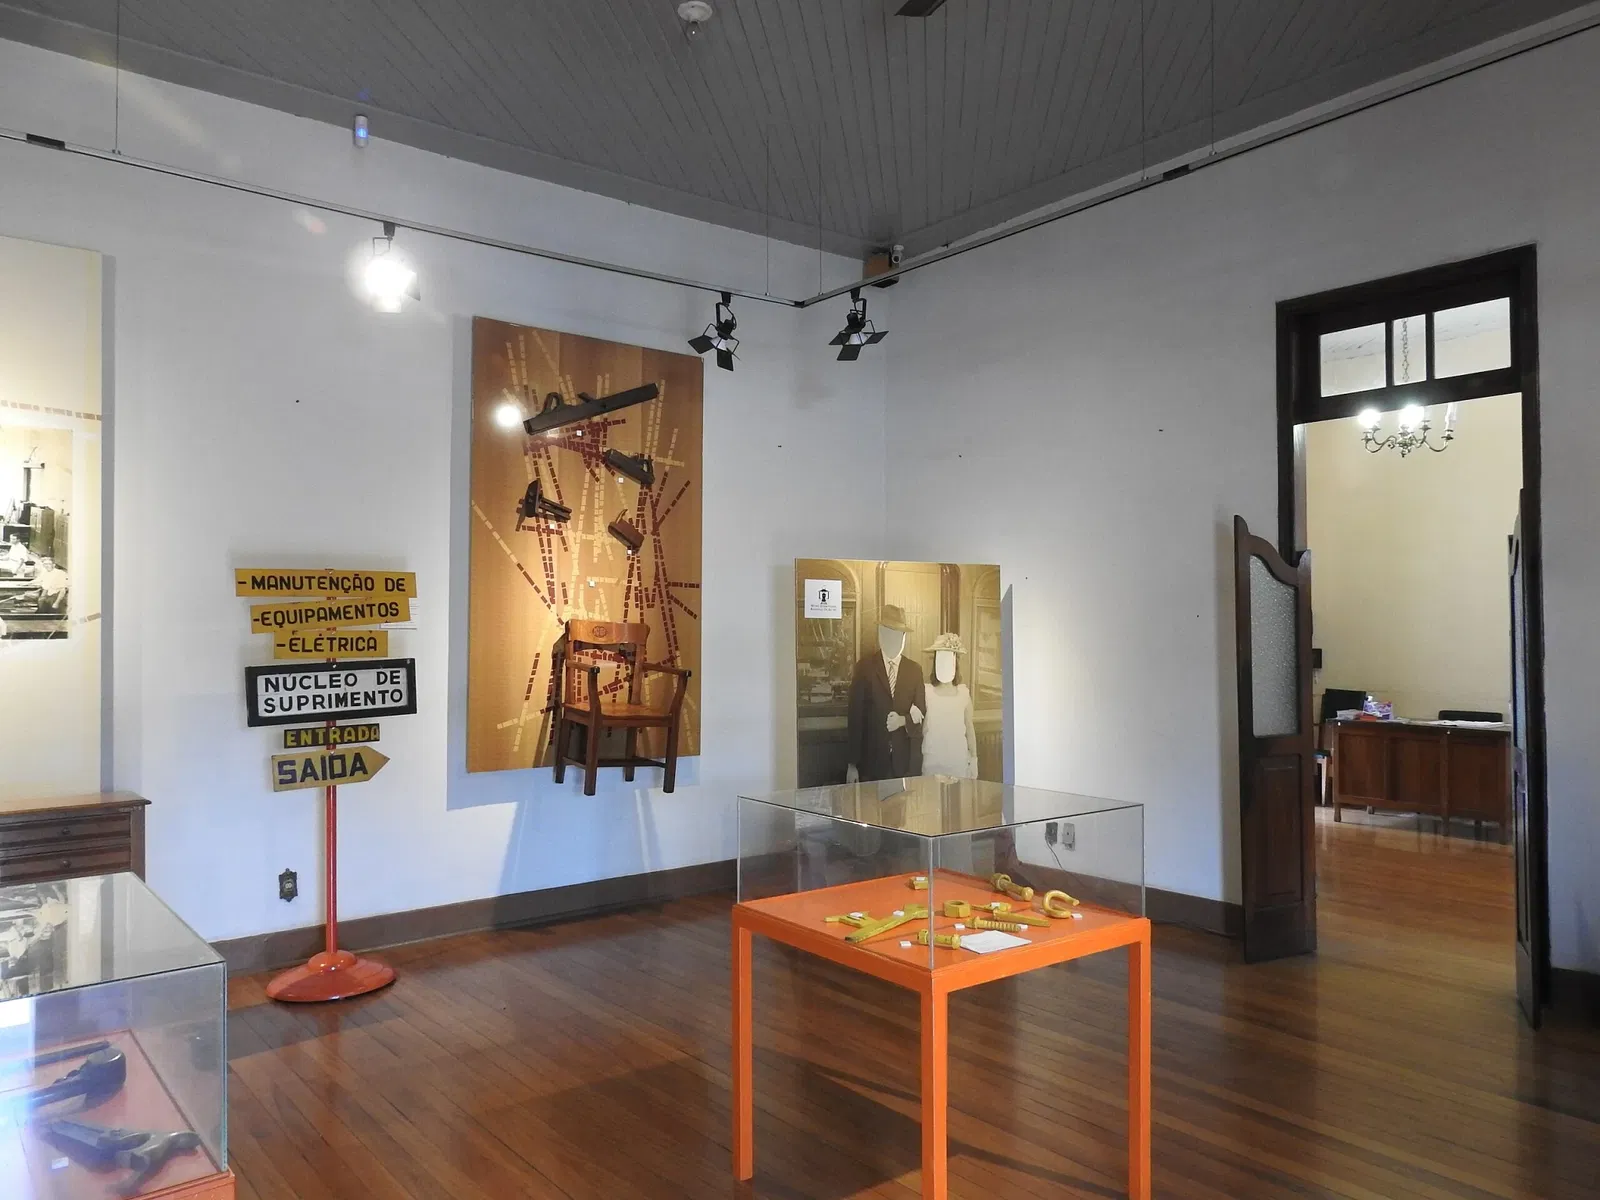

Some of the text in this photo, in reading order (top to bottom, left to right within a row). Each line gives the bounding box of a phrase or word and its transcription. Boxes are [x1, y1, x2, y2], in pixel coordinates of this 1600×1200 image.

[384, 577, 406, 592] DE
[264, 670, 401, 693] NÚCLEO DE
[263, 688, 403, 713] SUPRIMENTO
[286, 725, 379, 746] ENTRADA
